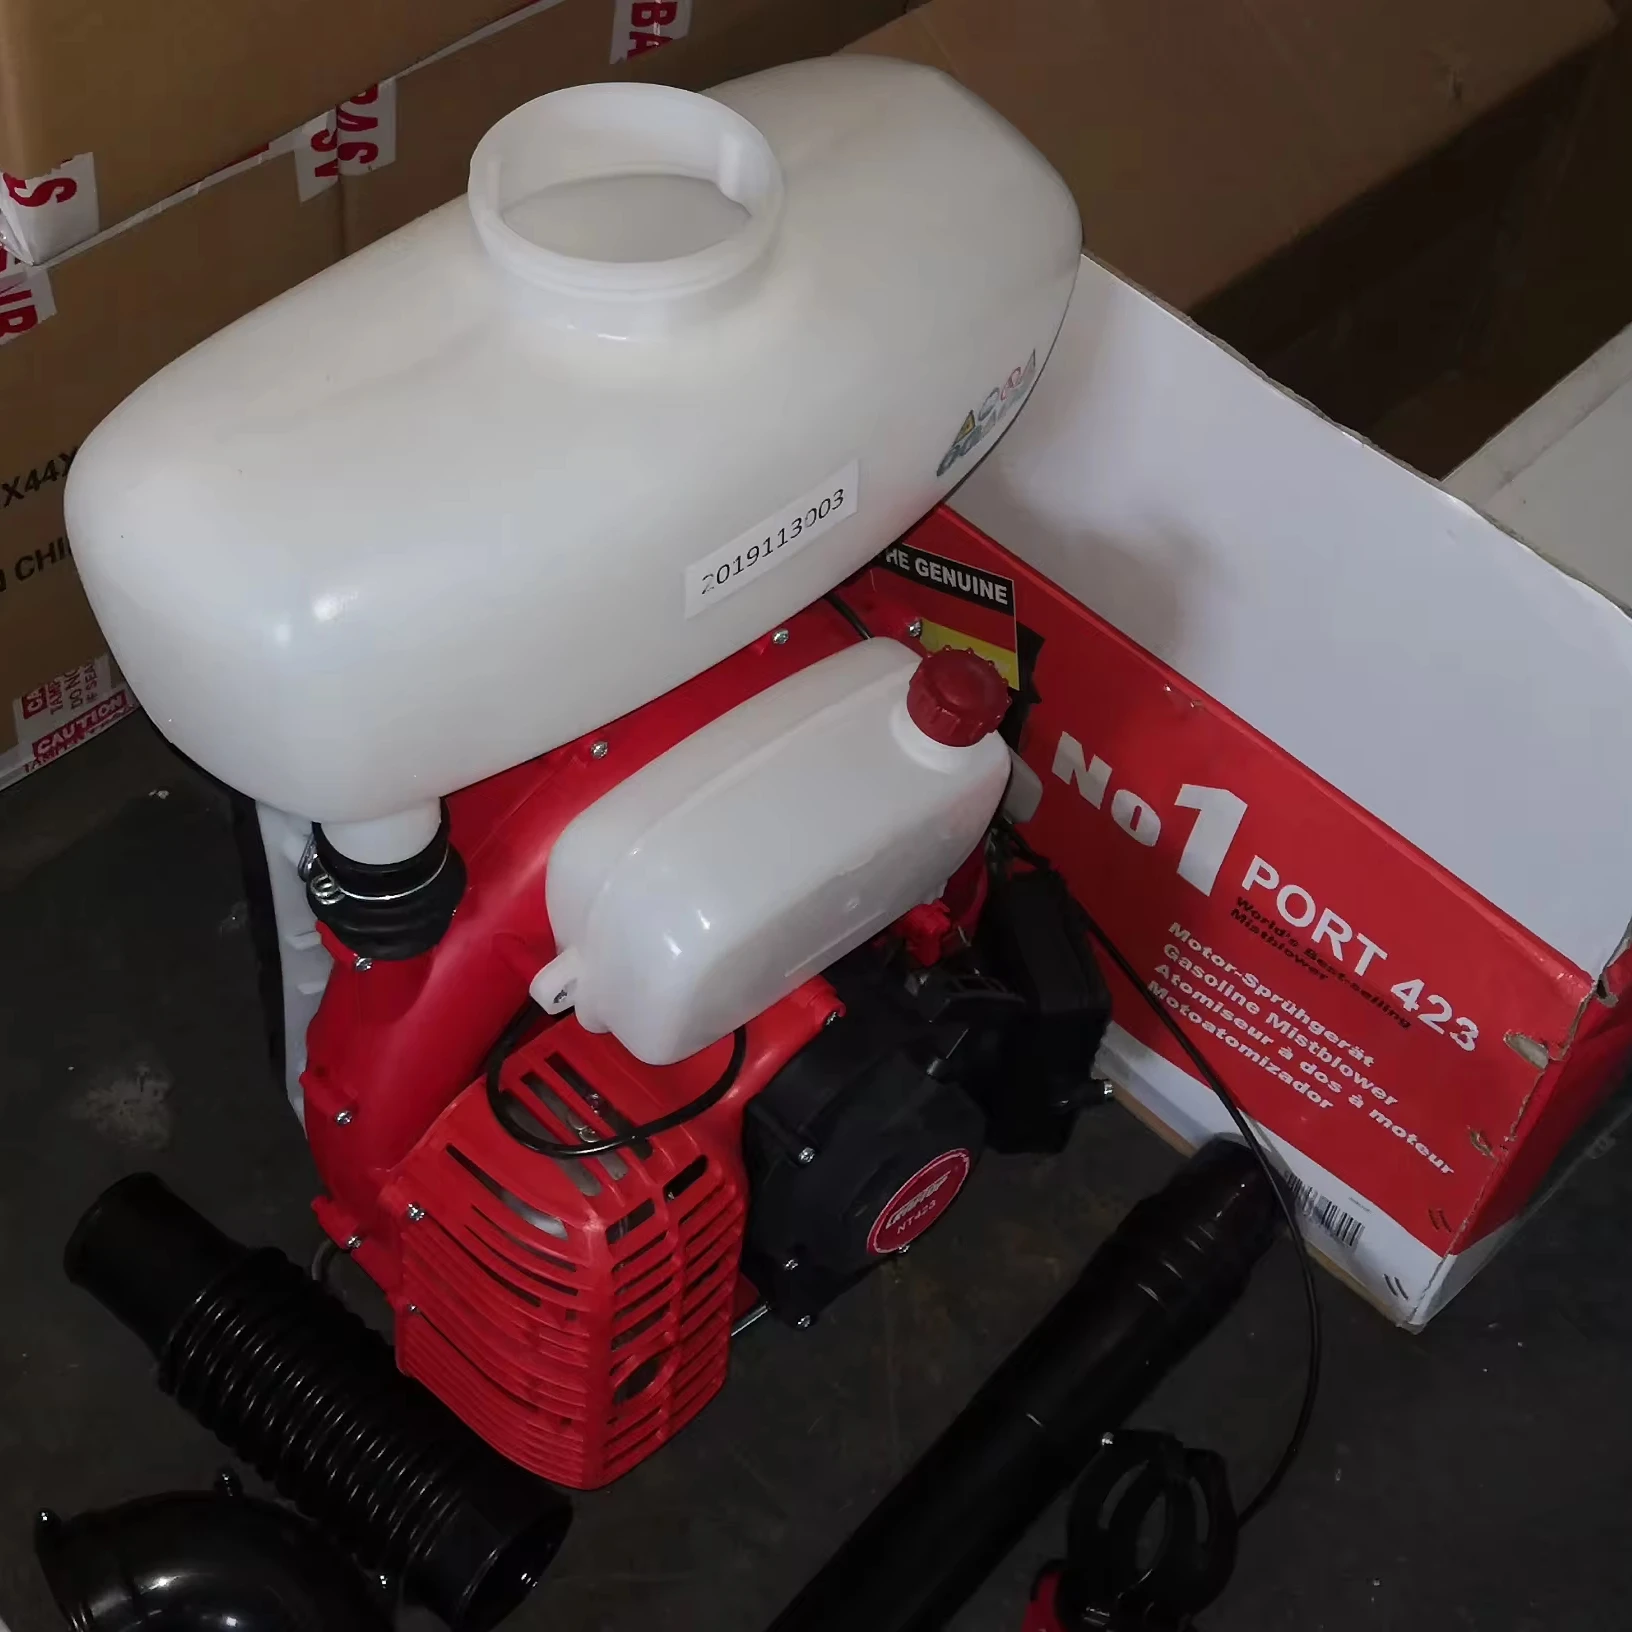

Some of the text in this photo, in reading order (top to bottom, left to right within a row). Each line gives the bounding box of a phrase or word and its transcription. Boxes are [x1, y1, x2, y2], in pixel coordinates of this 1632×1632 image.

[702, 488, 844, 594] 2019113003
[884, 548, 1008, 605] HE GENUINE
[37, 694, 122, 755] CAUTION
[1051, 730, 1248, 897] No 1
[1168, 922, 1375, 1068] Motor-Sprühgerät
[1230, 908, 1329, 980] Mistblower
[1236, 896, 1412, 1029] World's Best-selling
[1241, 854, 1479, 1052] PORT 423
[1147, 980, 1335, 1109] Motoatomizador
[1155, 964, 1274, 1045] Atomiseur
[1299, 1060, 1343, 1094] dos
[1369, 1108, 1455, 1174] moteur
[1164, 943, 1398, 1106] Gasoline Mistblower
